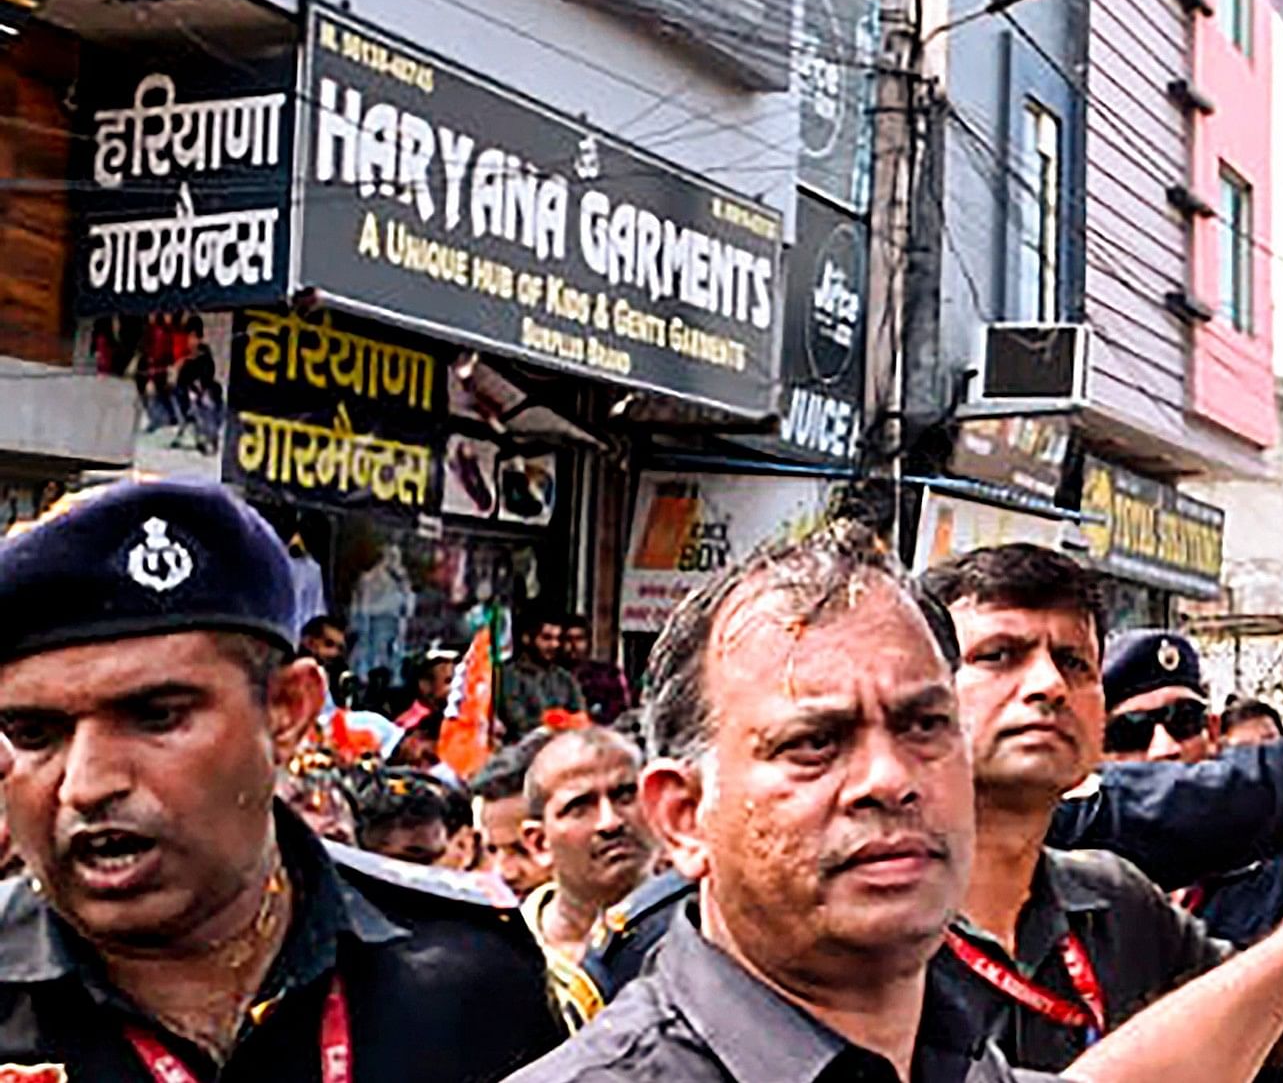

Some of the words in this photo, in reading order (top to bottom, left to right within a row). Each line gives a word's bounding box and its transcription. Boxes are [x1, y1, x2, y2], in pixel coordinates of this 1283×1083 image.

[94, 72, 287, 189] हरियाणा
[316, 77, 568, 260] HARYANA
[580, 190, 772, 330] GARMENTS
[358, 212, 380, 259] A
[386, 220, 470, 287] UNIQUE
[517, 271, 544, 307] OF
[594, 292, 610, 331] &
[245, 308, 436, 412] हरियाणा
[781, 387, 852, 457] JUICE
